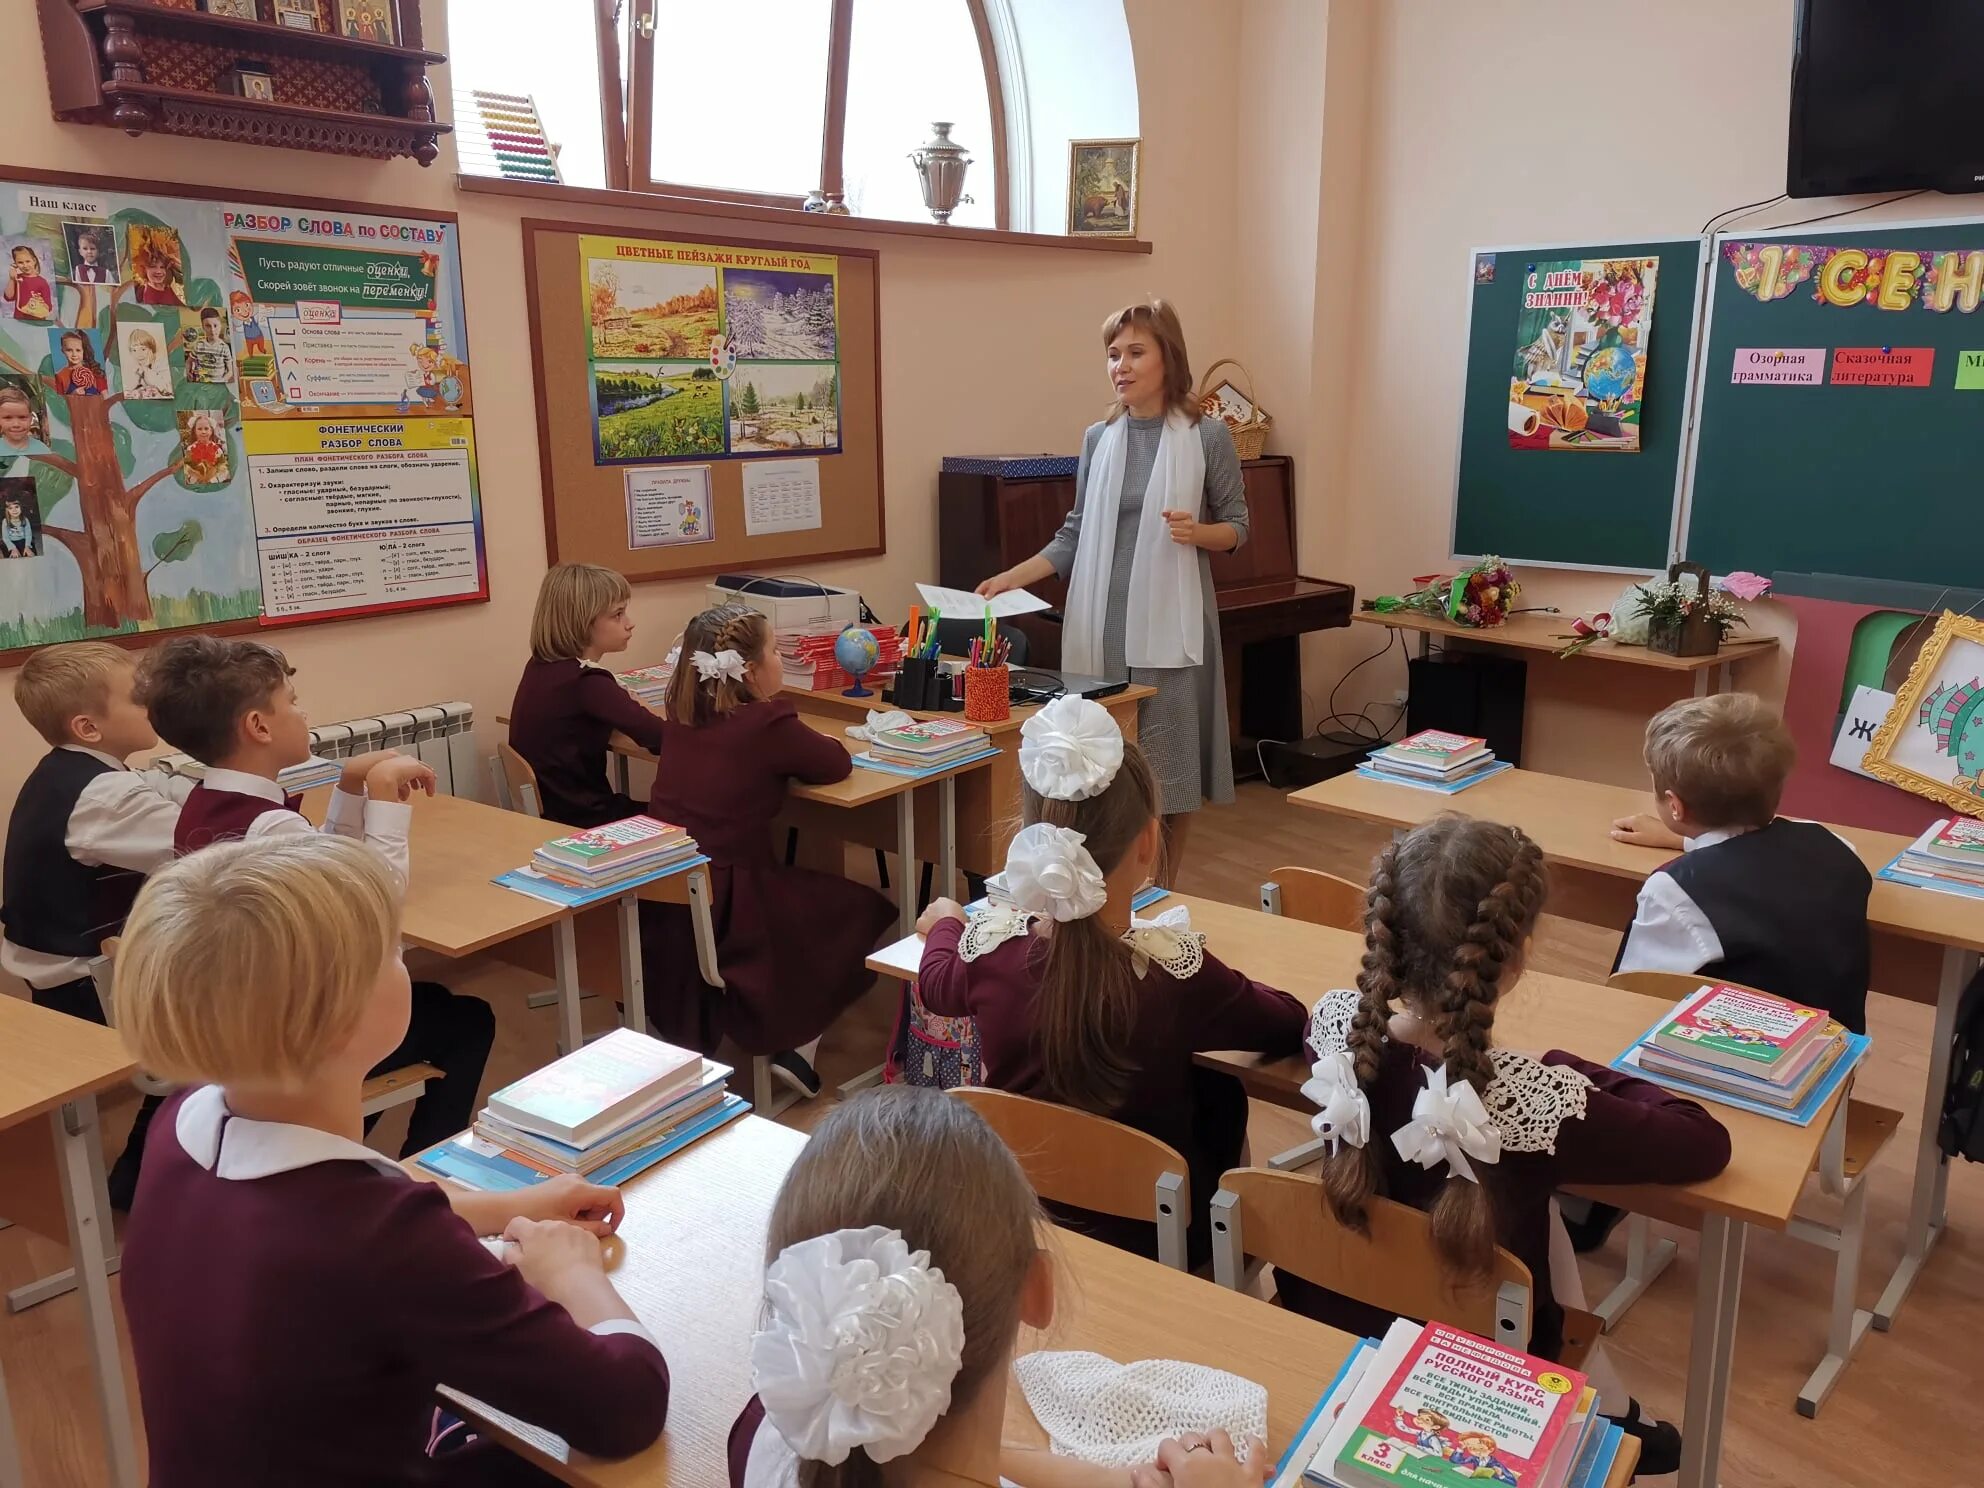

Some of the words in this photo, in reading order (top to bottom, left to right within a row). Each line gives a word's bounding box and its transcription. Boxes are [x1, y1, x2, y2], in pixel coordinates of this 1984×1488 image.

[29, 195, 58, 209] Наш
[62, 201, 97, 212] класс
[223, 212, 292, 232] РАЗБОР
[298, 217, 353, 236] СЛОВА
[358, 225, 376, 237] по
[380, 224, 444, 243] СОСТАВУ
[259, 257, 286, 270] Пусть
[287, 261, 321, 272] радуют
[323, 263, 364, 273] отличные
[616, 245, 674, 260] ЦВЕТНЫЕ
[676, 249, 734, 265] ПЕЙЗАЖИ
[735, 254, 788, 268] КРУГЛЫЙ
[790, 258, 811, 270] ГОД
[1528, 273, 1537, 288] С
[1545, 269, 1583, 289] ДНЁМ
[1758, 246, 1784, 302] 1
[257, 279, 291, 292] Скорей
[293, 282, 317, 292] зовёт
[319, 284, 349, 294] звонок
[350, 286, 360, 294] на
[1526, 288, 1588, 307] ЗНАНИЙ!
[302, 328, 323, 336] Основа
[302, 341, 333, 349] Приставка
[1749, 352, 1805, 367] Озорная
[1835, 352, 1912, 364] Сказочная
[1966, 355, 1984, 367] М
[1733, 371, 1813, 385] грамматика
[1831, 372, 1914, 386] литература
[321, 439, 362, 449] РАЗБОР
[368, 438, 403, 447] СЛОВА
[317, 454, 374, 462] ФОНЕТИЧЕСКОГО
[297, 536, 328, 545] ОБРАЗЕЦ
[331, 532, 387, 542] ФОНЕТИЧЕСКОГО
[389, 529, 417, 537] РАЗБОРА
[1435, 1352, 1501, 1381] ПОЛНЫЙ
[1504, 1377, 1546, 1398] КУРС
[1412, 1374, 1432, 1385] ВСЕ
[1434, 1382, 1465, 1398] ВИДЫ
[1424, 1358, 1493, 1388] РУССКОГО
[1496, 1384, 1545, 1409] ЯЗЫКА
[1426, 1372, 1447, 1382] ВСЕ
[1449, 1380, 1477, 1395] ТИПЫ
[1438, 1392, 1459, 1402] ВСЕ
[1404, 1387, 1421, 1397] ВСЕ
[1423, 1394, 1493, 1424] КОНТРОЛЬНЫЕ
[1422, 1401, 1440, 1412] ВСЕ
[1443, 1409, 1471, 1425] ВИДЫ
[1473, 1421, 1509, 1438] ТЕСТОВ
[1373, 1442, 1392, 1459] 3
[1360, 1453, 1392, 1469] класс
[1400, 1468, 1419, 1480] для
